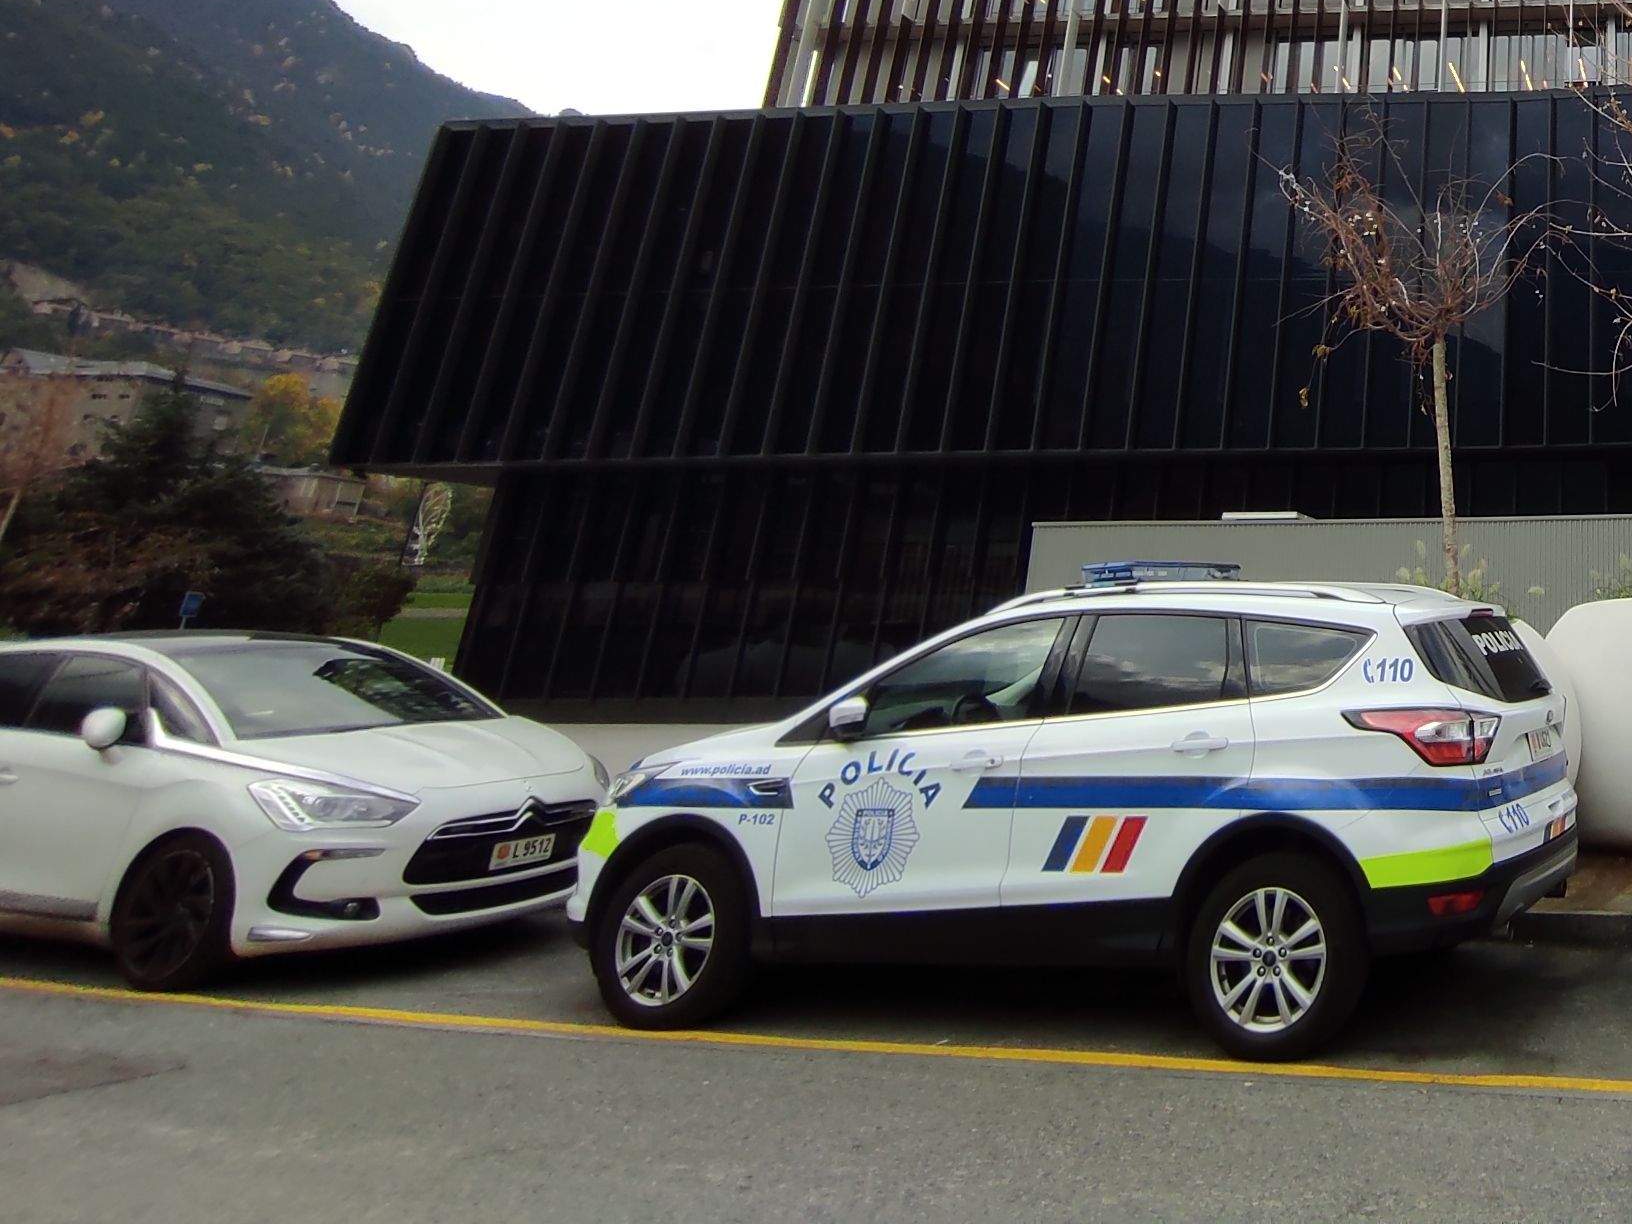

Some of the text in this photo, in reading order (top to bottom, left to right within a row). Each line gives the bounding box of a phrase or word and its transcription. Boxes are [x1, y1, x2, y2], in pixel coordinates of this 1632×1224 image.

[1376, 658, 1414, 682] 110
[681, 764, 771, 777] www.policia.ad
[817, 748, 942, 809] POLICIA
[738, 813, 775, 825] P-102
[1505, 803, 1530, 831] 110
[511, 837, 552, 859] L 9512
